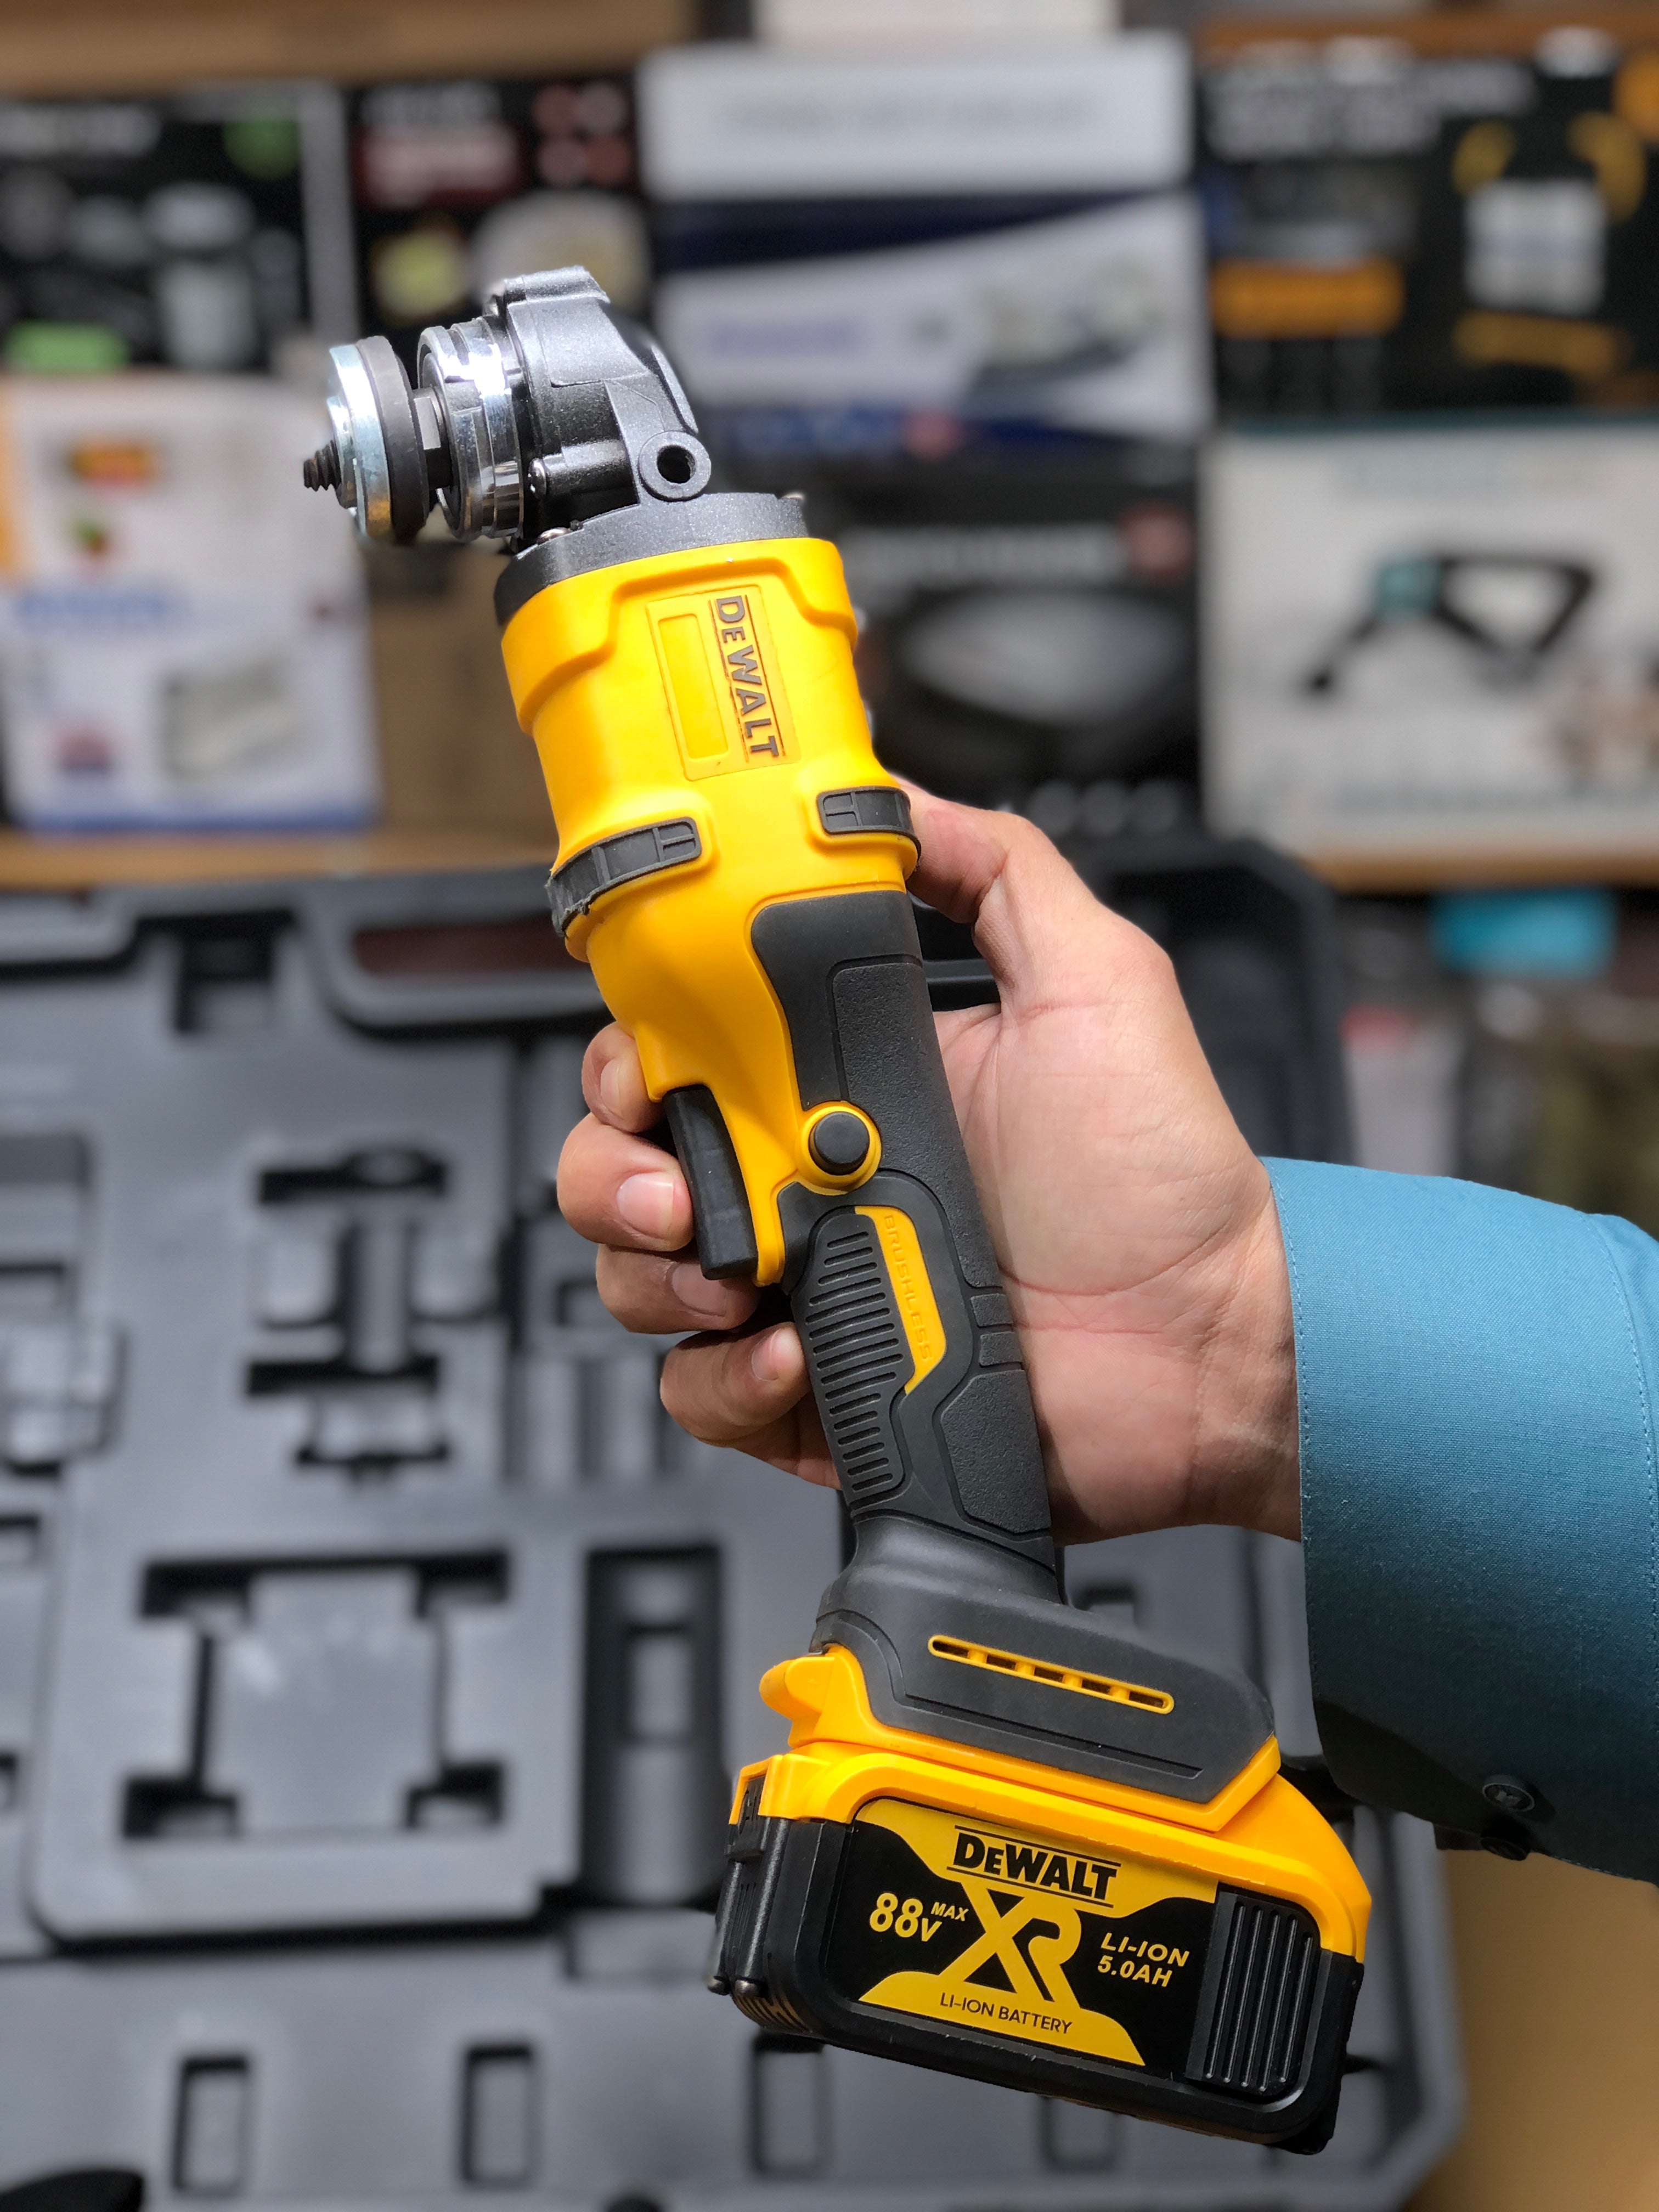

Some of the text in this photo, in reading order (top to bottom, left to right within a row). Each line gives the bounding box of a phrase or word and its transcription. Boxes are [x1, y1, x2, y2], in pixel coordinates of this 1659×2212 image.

[884, 1214, 933, 1361] BRUSHLESS
[930, 1901, 969, 1921] MAX
[938, 1882, 1082, 2008] XR
[1101, 1932, 1190, 1967] LI-ION
[1098, 1955, 1172, 1988] 5.0AH
[940, 1992, 1073, 2034] LI-ION BATTERY
